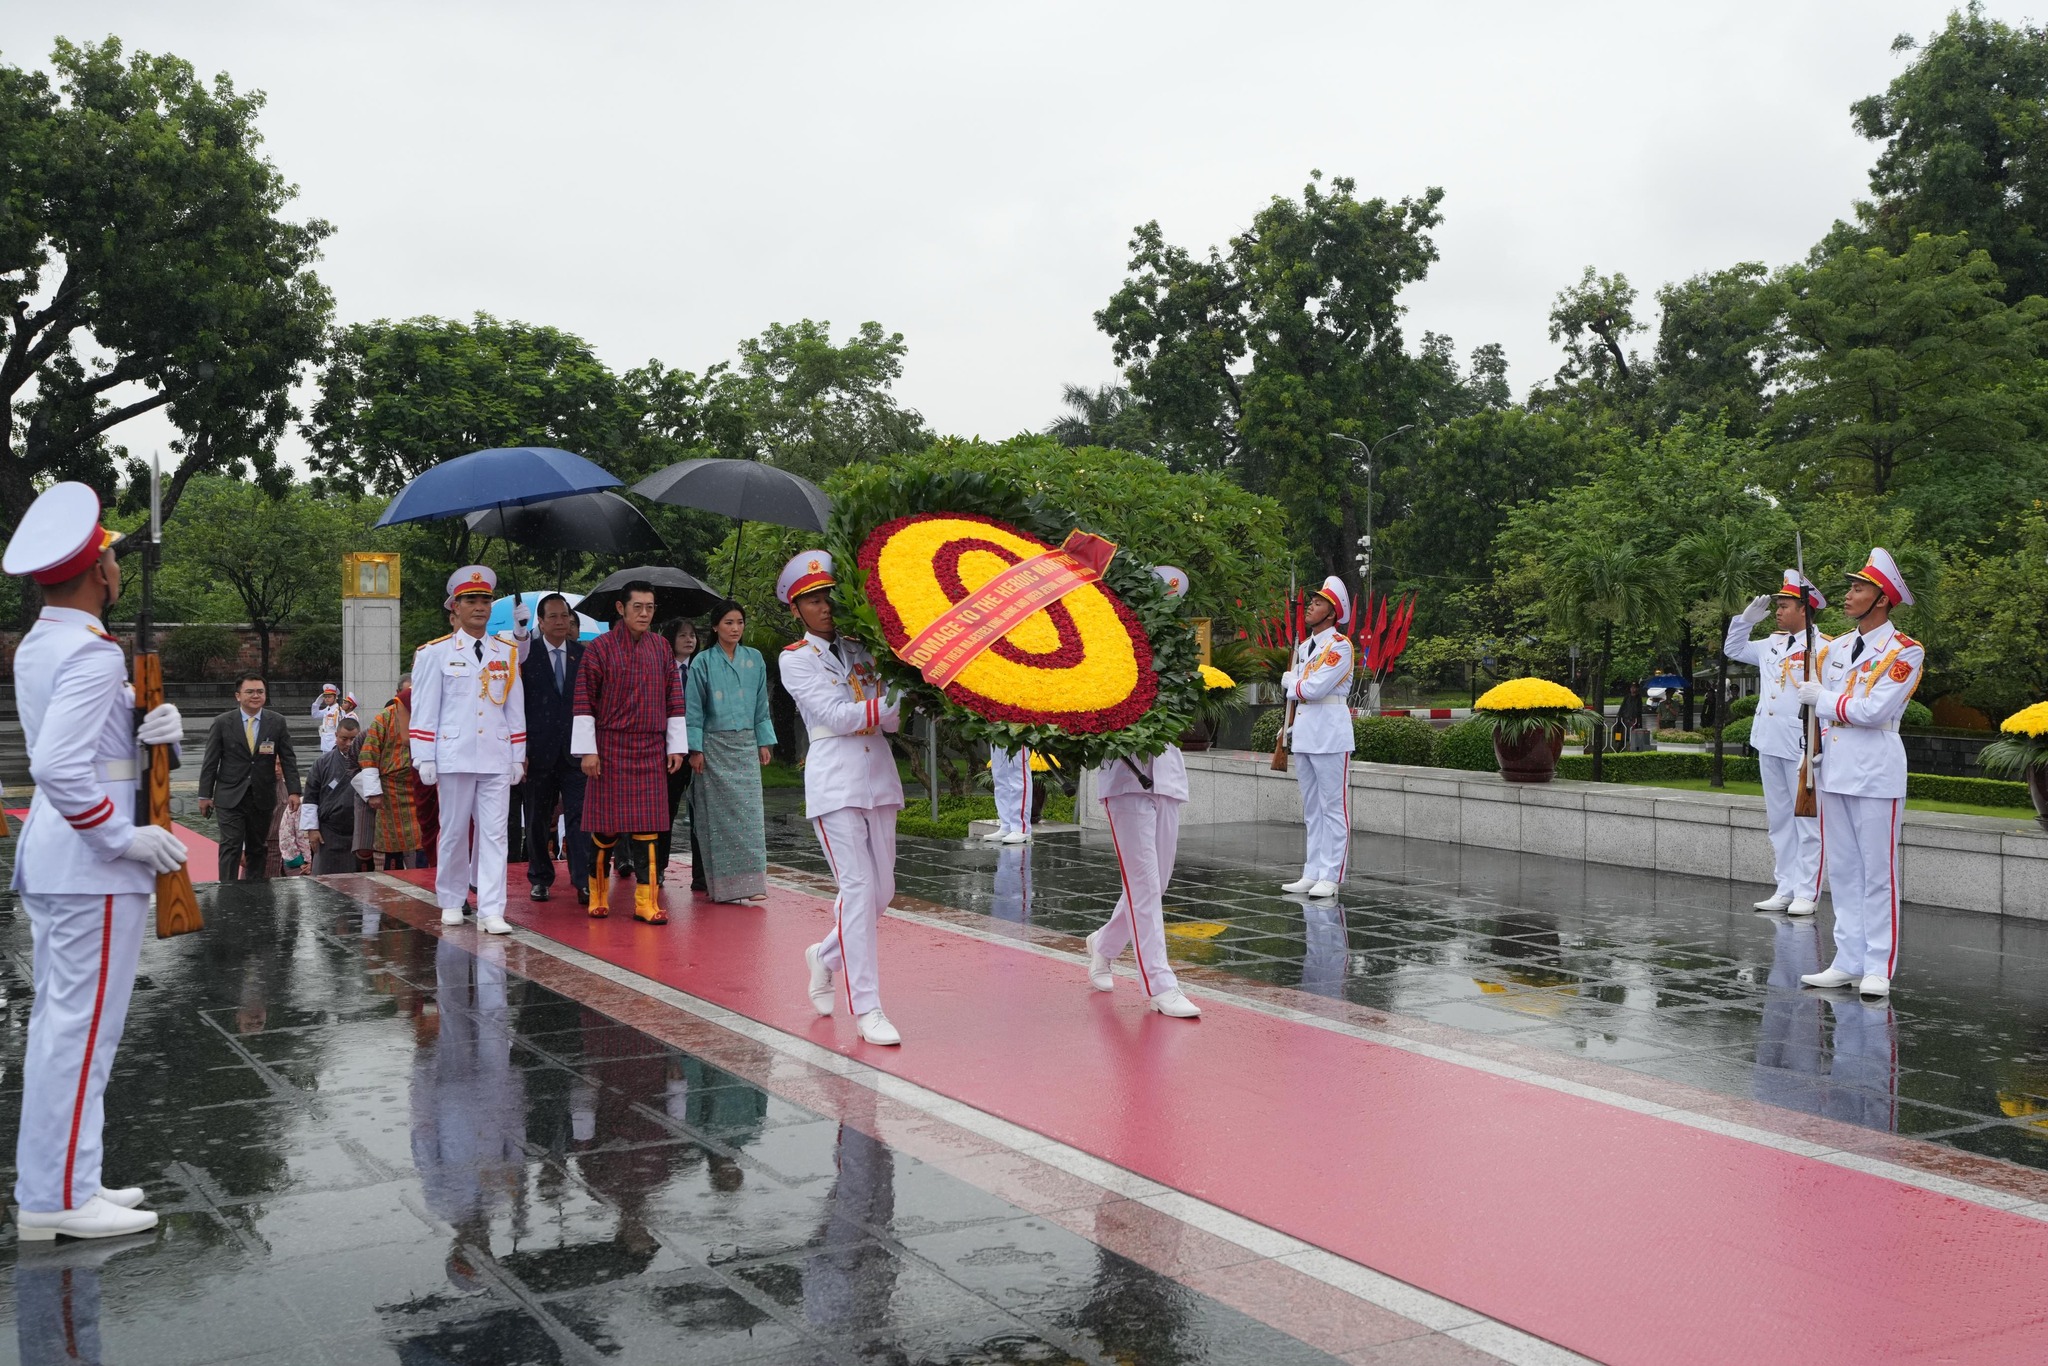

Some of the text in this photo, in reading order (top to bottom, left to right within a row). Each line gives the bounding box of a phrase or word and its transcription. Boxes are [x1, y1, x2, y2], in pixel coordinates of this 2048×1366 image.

[908, 621, 966, 670] HOMAGE
[955, 609, 981, 625] TO
[971, 593, 1004, 613] THE
[993, 570, 1040, 598] HEROIC
[928, 660, 952, 680] FROM
[958, 625, 994, 650] MAJESTIES
